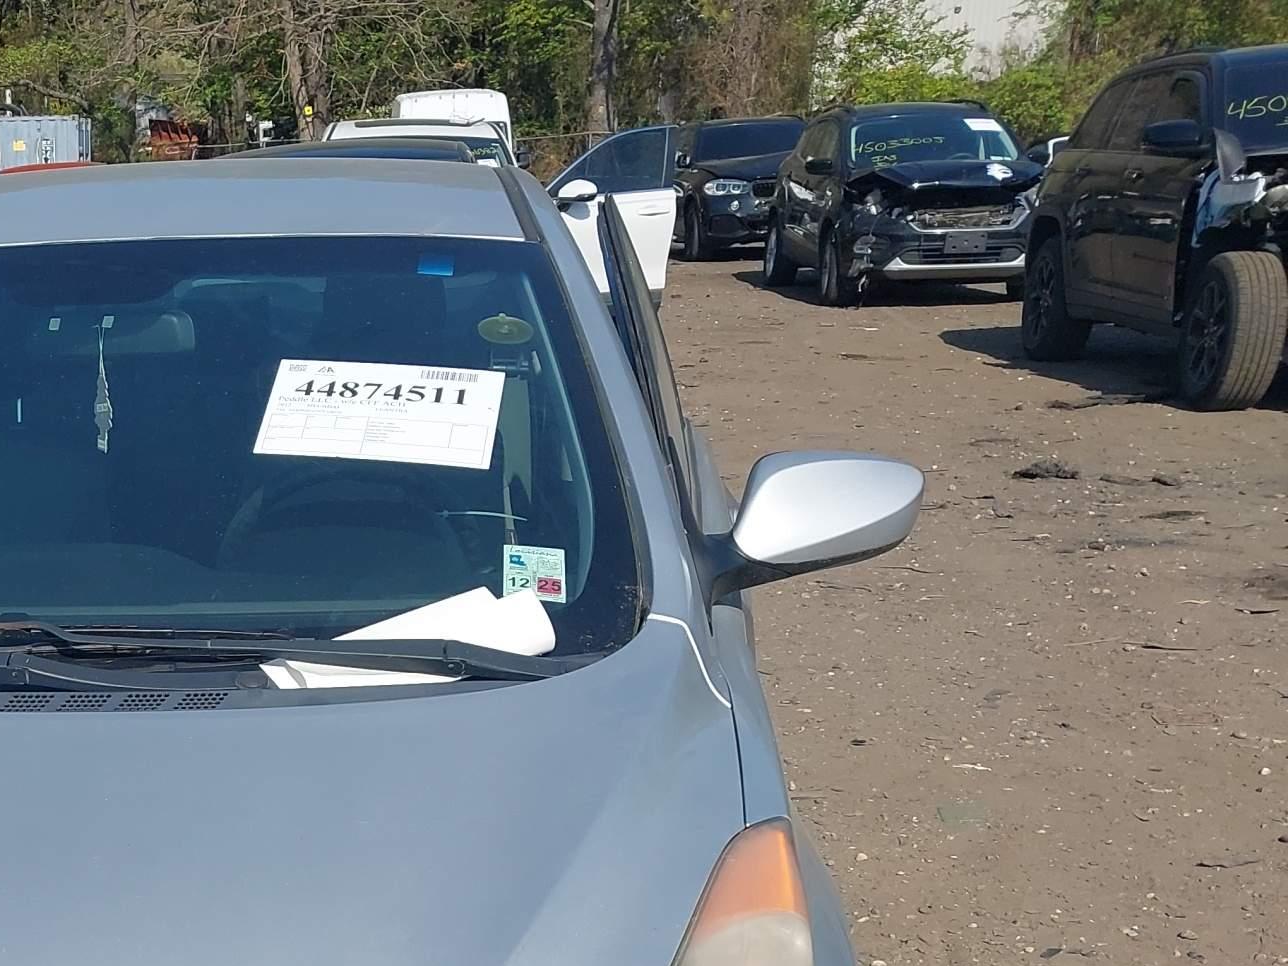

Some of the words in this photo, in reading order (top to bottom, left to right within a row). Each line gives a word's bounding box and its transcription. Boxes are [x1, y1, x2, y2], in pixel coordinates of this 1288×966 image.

[1227, 95, 1288, 120] 450
[295, 379, 468, 406] 44874511
[508, 577, 530, 589] 12
[538, 579, 562, 591] 25
